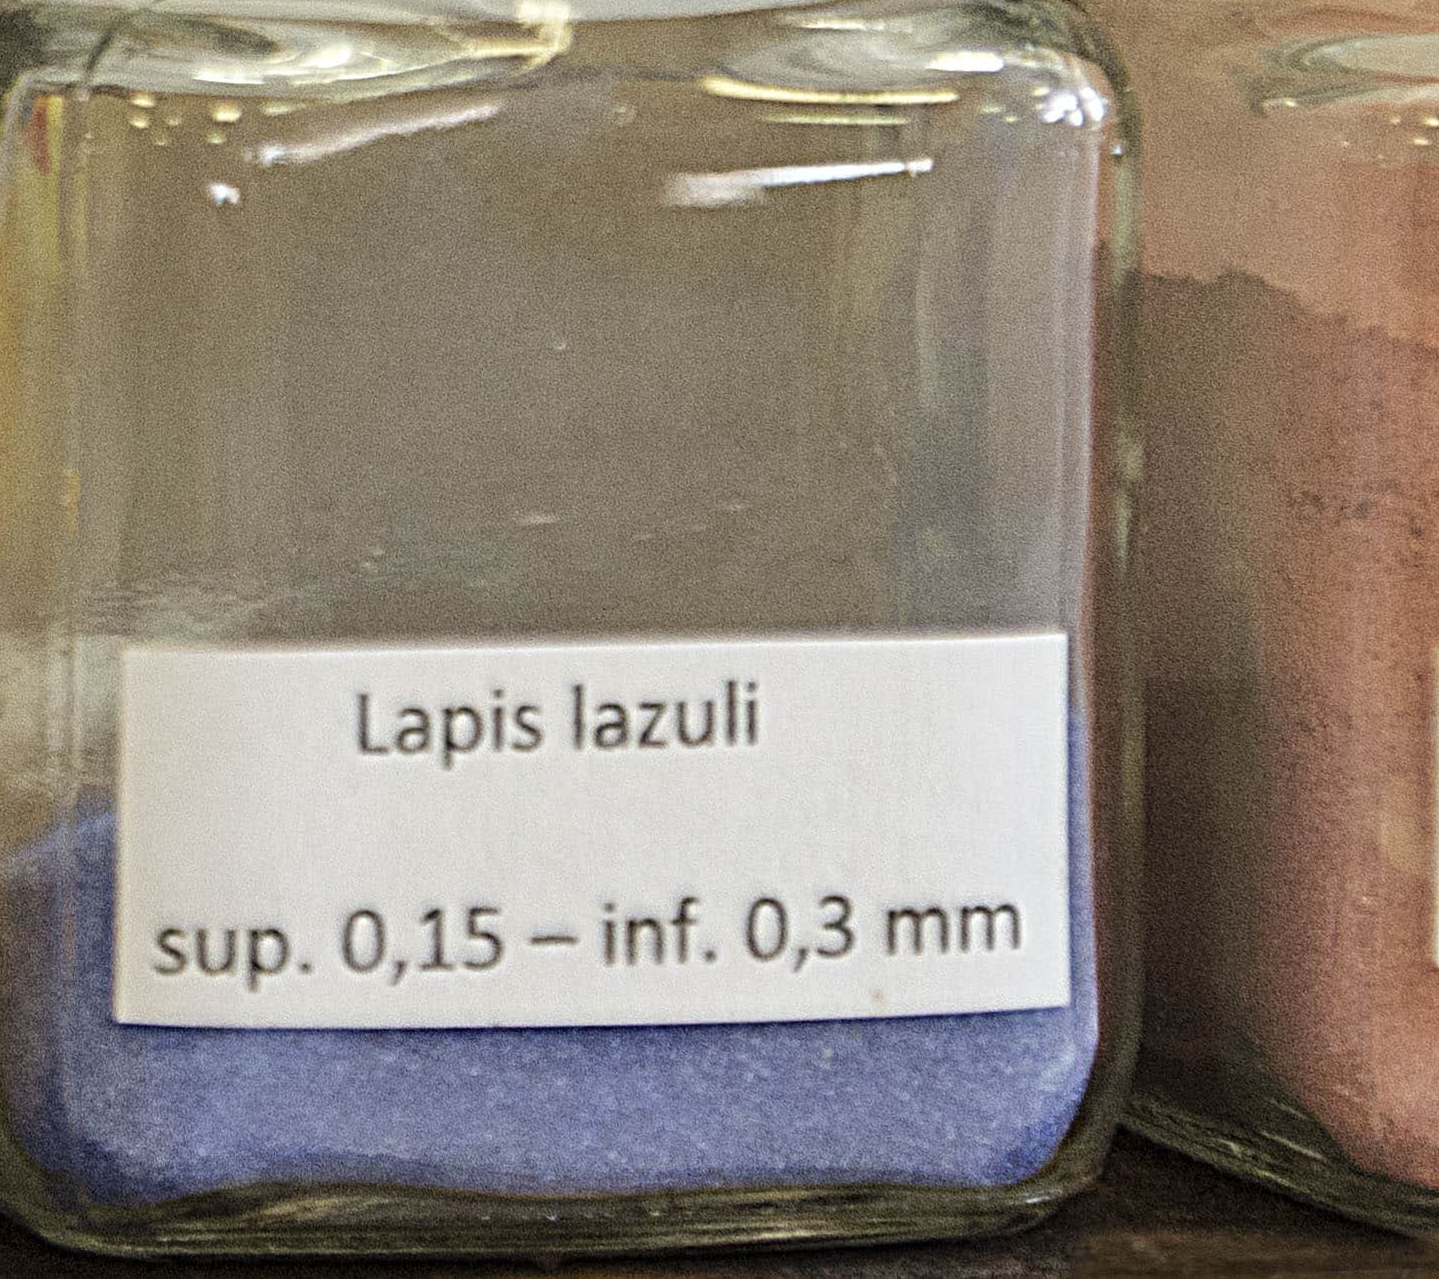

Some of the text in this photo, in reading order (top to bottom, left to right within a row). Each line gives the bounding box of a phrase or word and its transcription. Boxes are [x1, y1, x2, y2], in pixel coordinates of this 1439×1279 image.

[355, 680, 761, 769] Lapis lazuli
[153, 919, 314, 992] sup.
[340, 905, 505, 984] 0,15
[602, 895, 718, 966] inf.
[744, 893, 857, 970] 0,3
[884, 897, 1023, 956] mm
